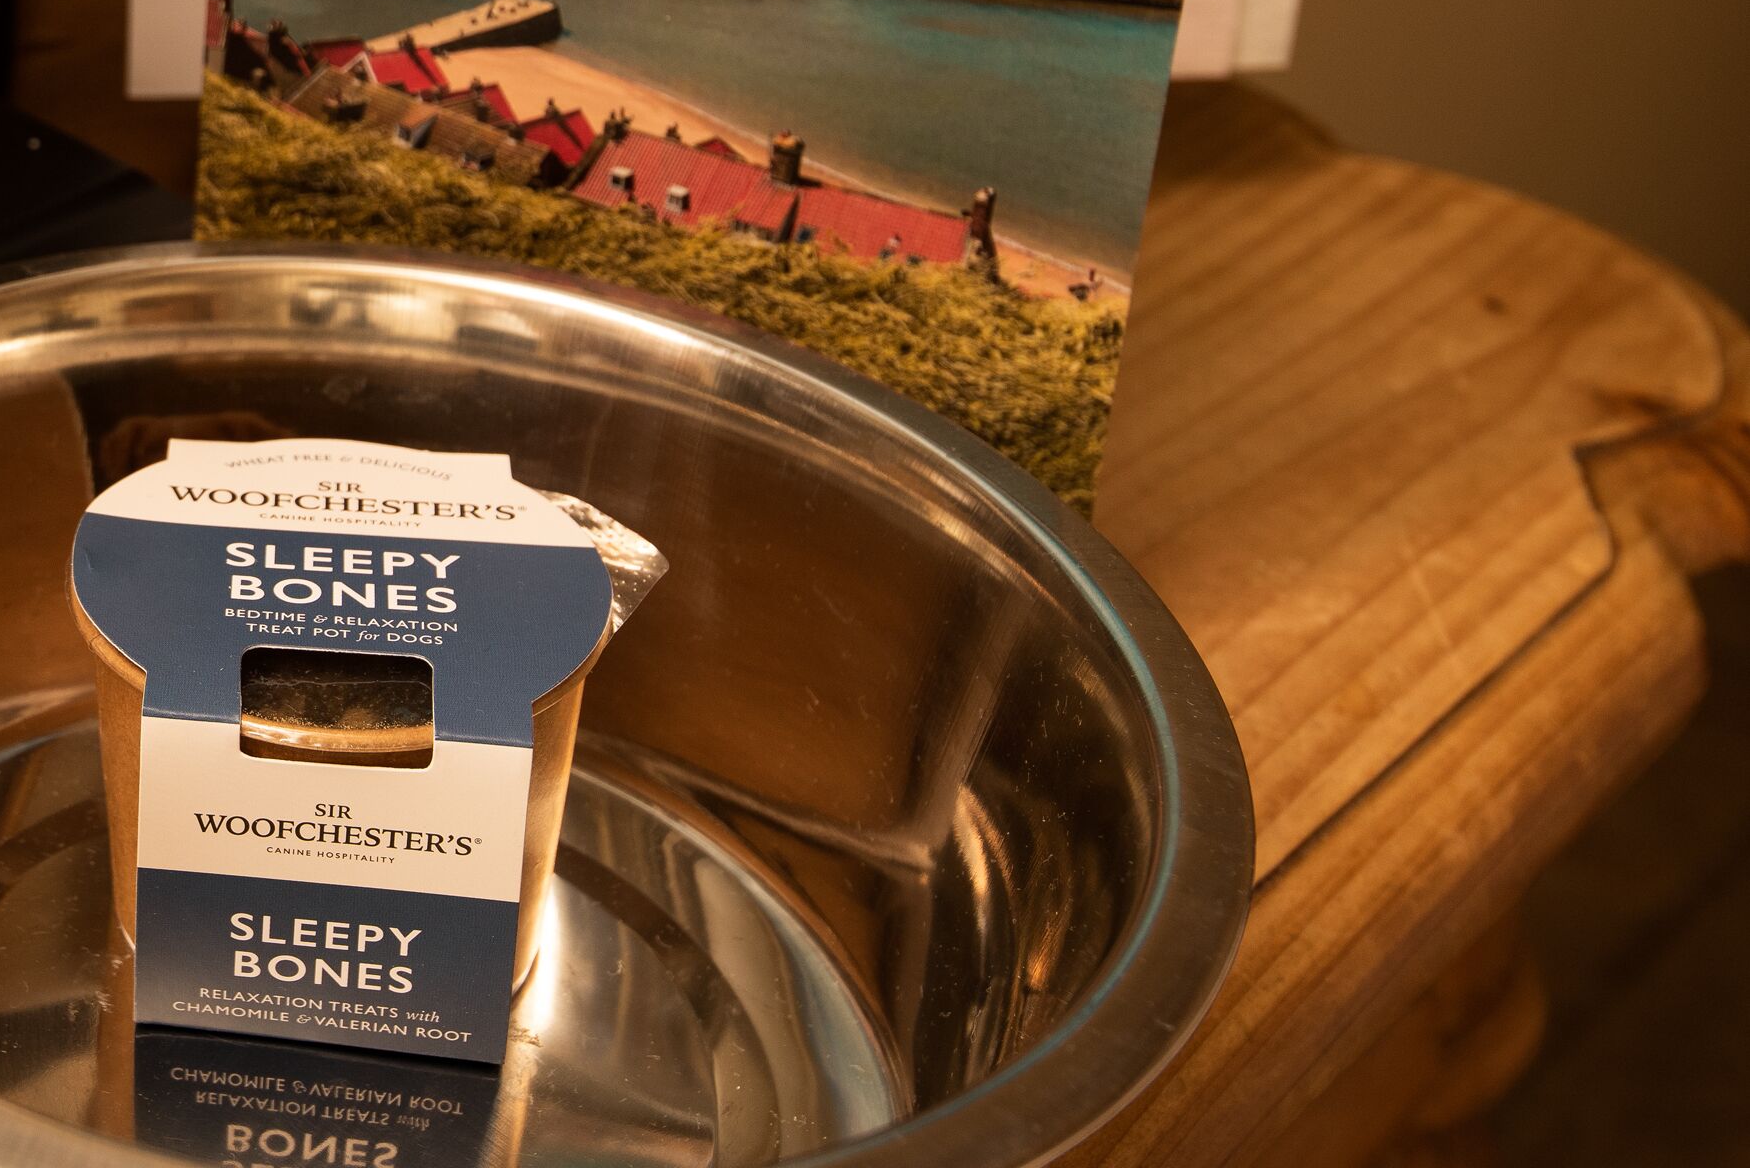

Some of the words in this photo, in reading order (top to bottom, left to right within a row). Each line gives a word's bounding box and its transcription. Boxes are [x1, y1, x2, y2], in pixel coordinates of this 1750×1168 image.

[225, 452, 286, 470] WHEAT
[292, 453, 333, 464] FREE
[339, 454, 353, 464] &
[359, 455, 454, 482] DELICIOUS
[317, 480, 365, 494] SIR
[258, 512, 316, 523] CANINE
[322, 516, 422, 529] HOSPITALITY
[225, 541, 462, 580] SLEEPY
[230, 573, 459, 614] BONES
[224, 607, 308, 623] BEDTIME
[312, 613, 330, 625] &
[333, 615, 459, 633] RELAXATION
[245, 622, 306, 637] TREAT
[312, 627, 352, 640] POT
[355, 629, 381, 643] for
[386, 632, 444, 646] DOGS
[313, 802, 354, 820] SIR
[266, 845, 312, 857] CANINE
[316, 850, 397, 864] HOSPITALITY
[229, 911, 423, 958] SLEEPY
[233, 949, 414, 995] BONES
[199, 986, 324, 1011] RELAXATION
[328, 999, 399, 1020] TREATS
[404, 1009, 441, 1024] with
[172, 1000, 290, 1023] CHAMOMILE
[295, 1013, 312, 1025] &
[313, 1015, 408, 1036] VALERIAN
[415, 1026, 472, 1043] ROOT
